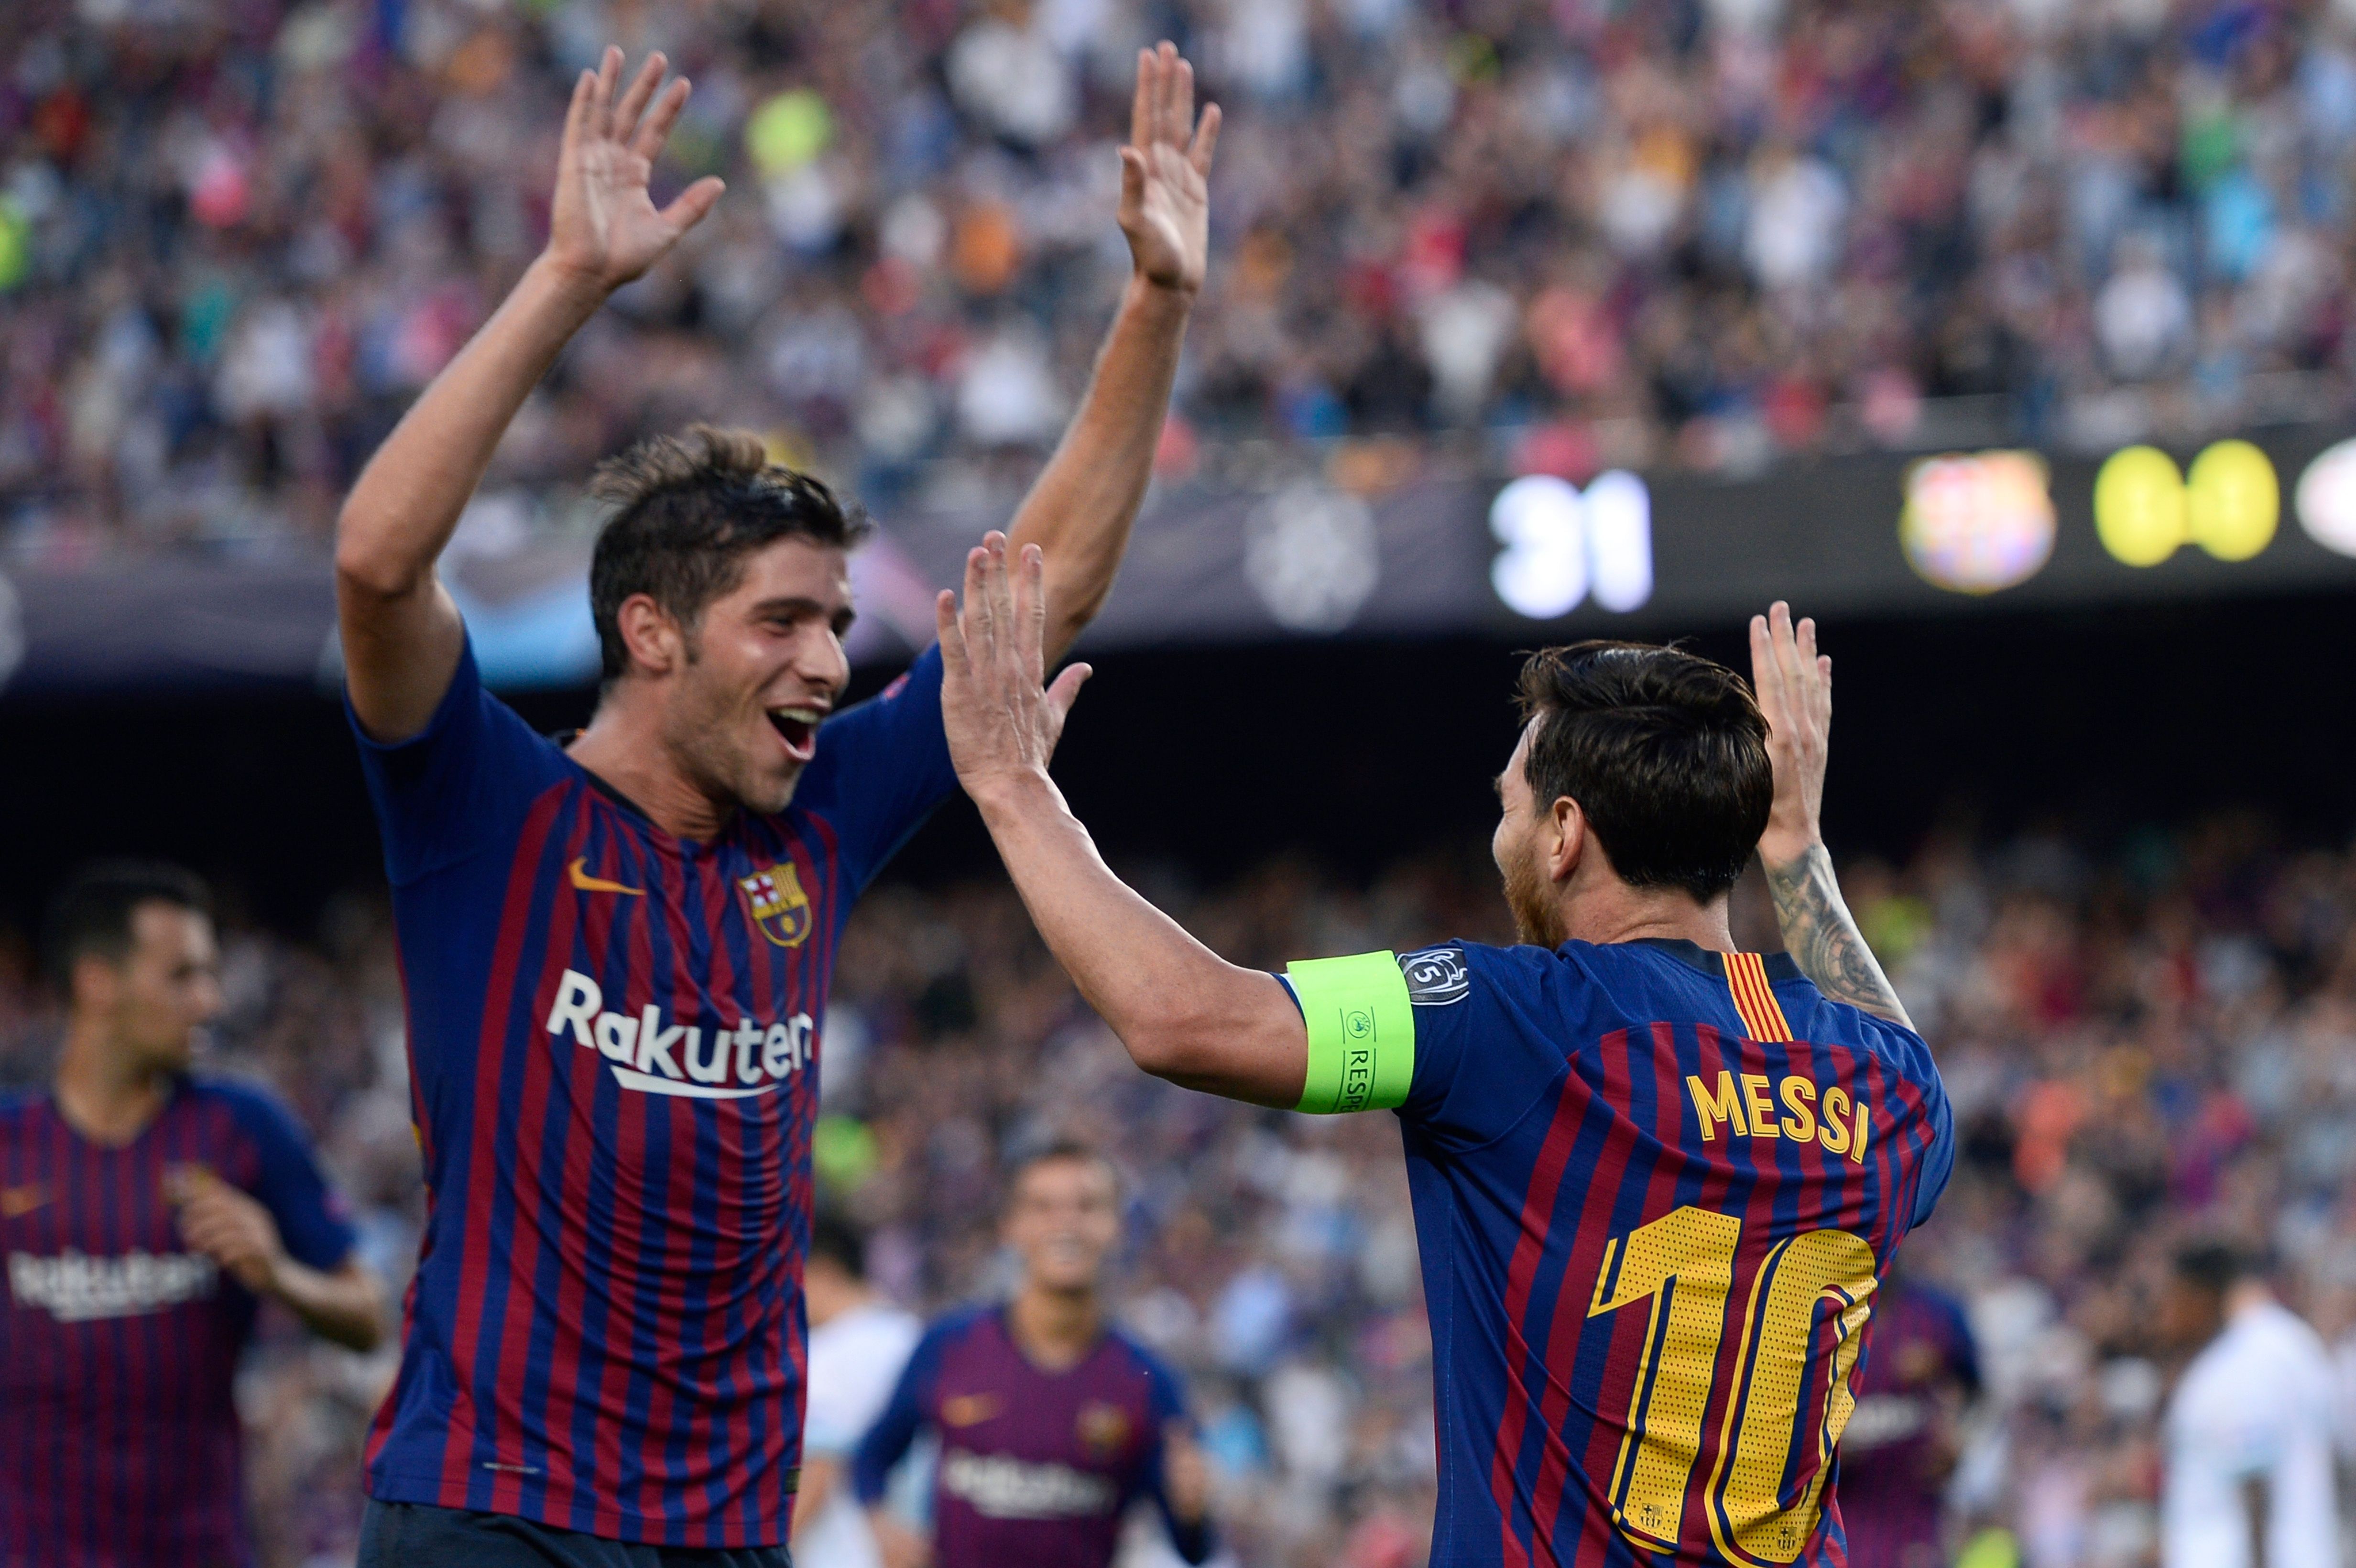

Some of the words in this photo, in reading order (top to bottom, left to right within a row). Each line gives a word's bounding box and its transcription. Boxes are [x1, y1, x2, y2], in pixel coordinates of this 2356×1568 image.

[1488, 468, 1654, 620] 31
[545, 968, 813, 1084] Rakuten
[1414, 966, 1441, 983] 5
[1686, 1070, 1869, 1165] MESSI
[1587, 1205, 1878, 1568] 10
